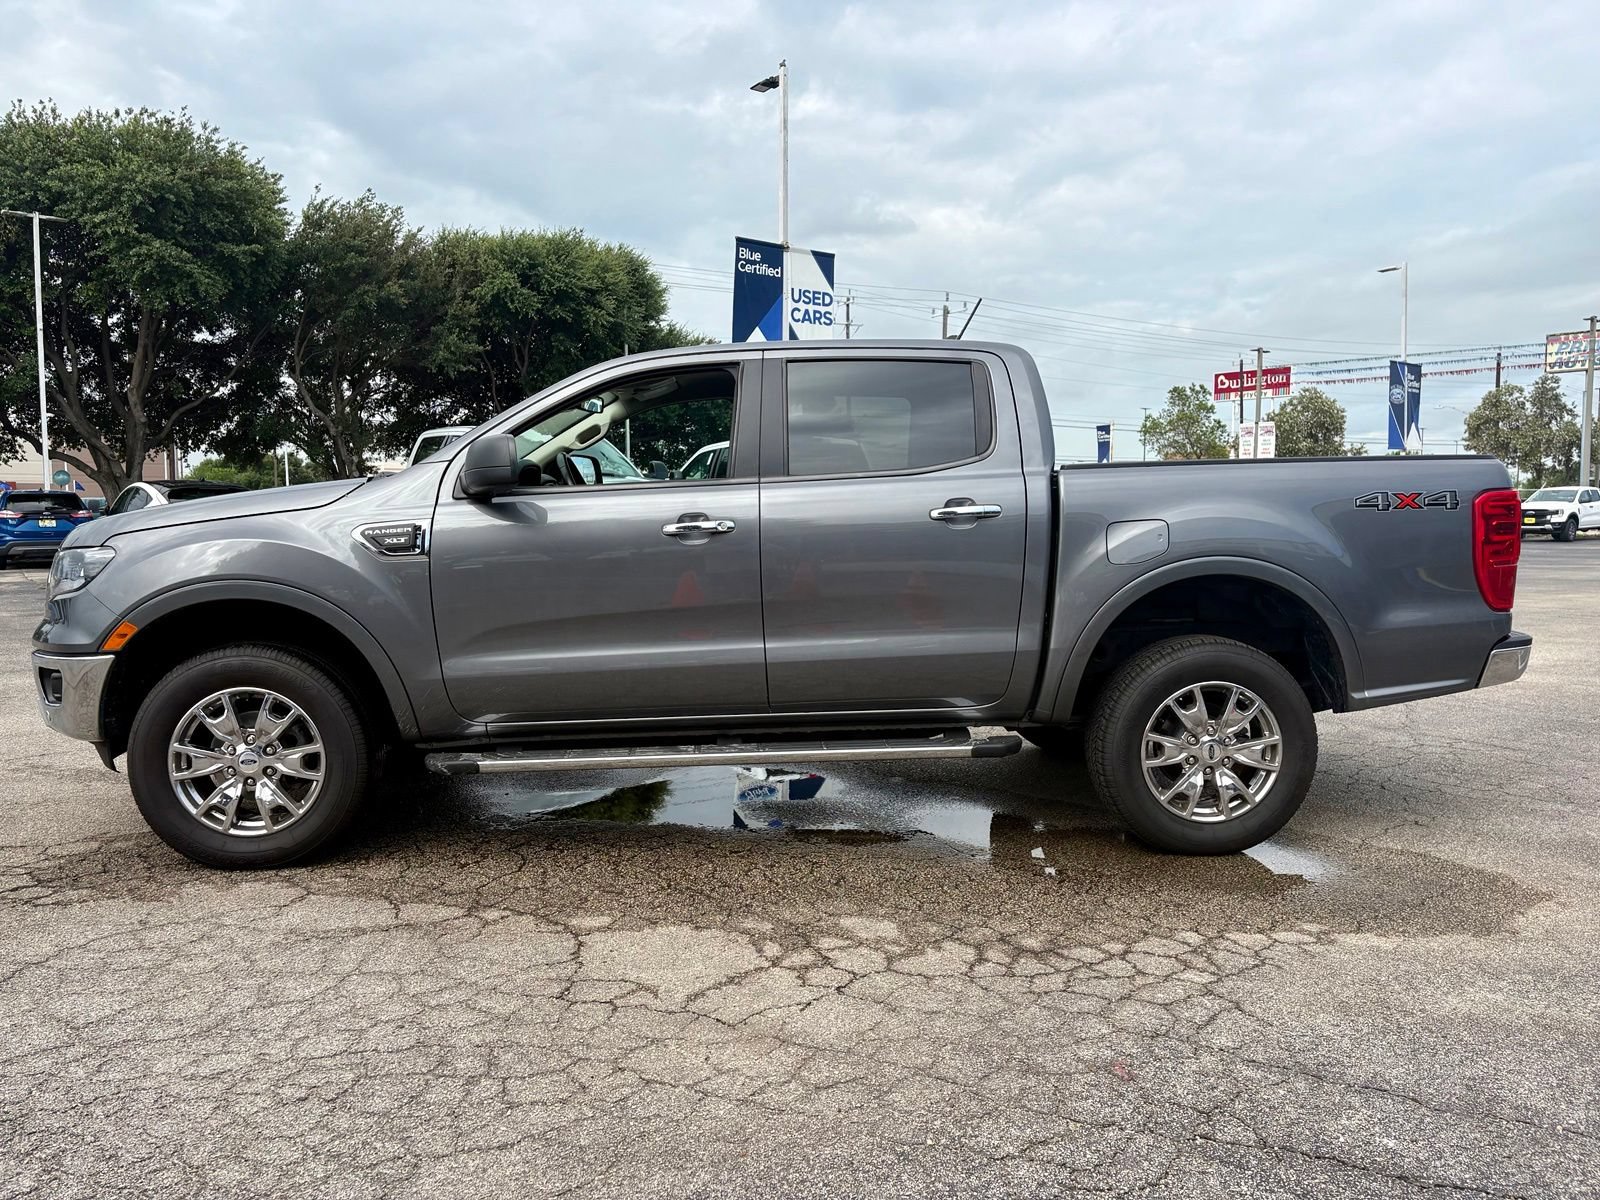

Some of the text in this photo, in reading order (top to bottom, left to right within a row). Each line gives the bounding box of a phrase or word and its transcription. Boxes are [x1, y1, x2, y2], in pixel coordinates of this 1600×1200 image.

[739, 247, 761, 261] Blue
[738, 261, 781, 277] Certified
[791, 288, 833, 307] USED
[791, 307, 833, 326] CARS
[365, 527, 412, 535] RANGER
[384, 536, 409, 544] XLT
